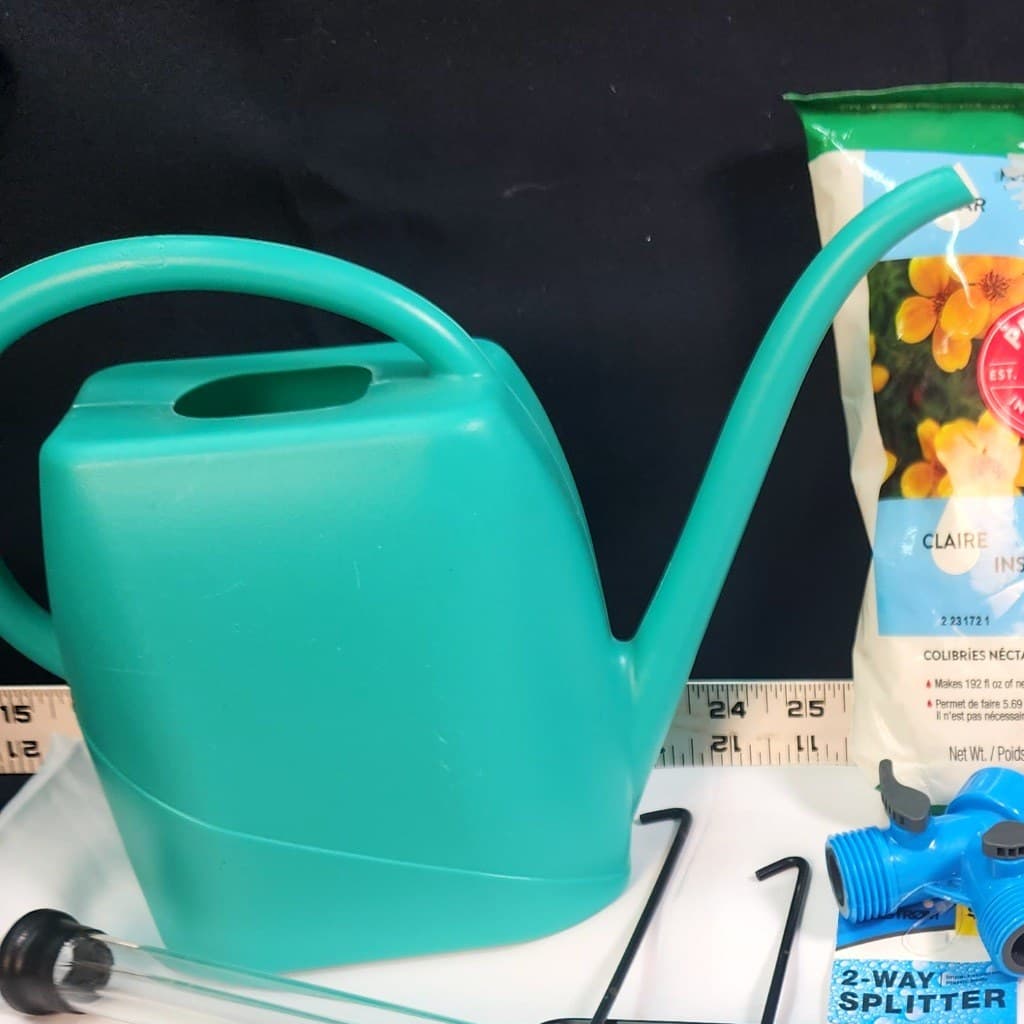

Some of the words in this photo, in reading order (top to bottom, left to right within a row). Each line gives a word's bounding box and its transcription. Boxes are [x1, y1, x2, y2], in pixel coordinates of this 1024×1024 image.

[989, 367, 1017, 381] EST.
[922, 532, 989, 550] CLAIRE
[934, 678, 963, 689] Makes
[966, 678, 982, 689] 192
[992, 680, 1002, 689] oz
[1004, 678, 1013, 689] of
[0, 705, 31, 723] 15
[709, 700, 747, 719] 24
[787, 700, 825, 719] 25
[935, 698, 966, 709] Permet
[968, 698, 979, 709] de
[981, 698, 1001, 709] faire
[1002, 698, 1023, 709] 5.69
[944, 711, 964, 720] n'est
[966, 712, 982, 722] pas
[949, 745, 968, 761] Net
[970, 745, 987, 761] Wt.
[840, 969, 936, 989] 2-WAY
[838, 988, 1007, 1015] SPLITTER
